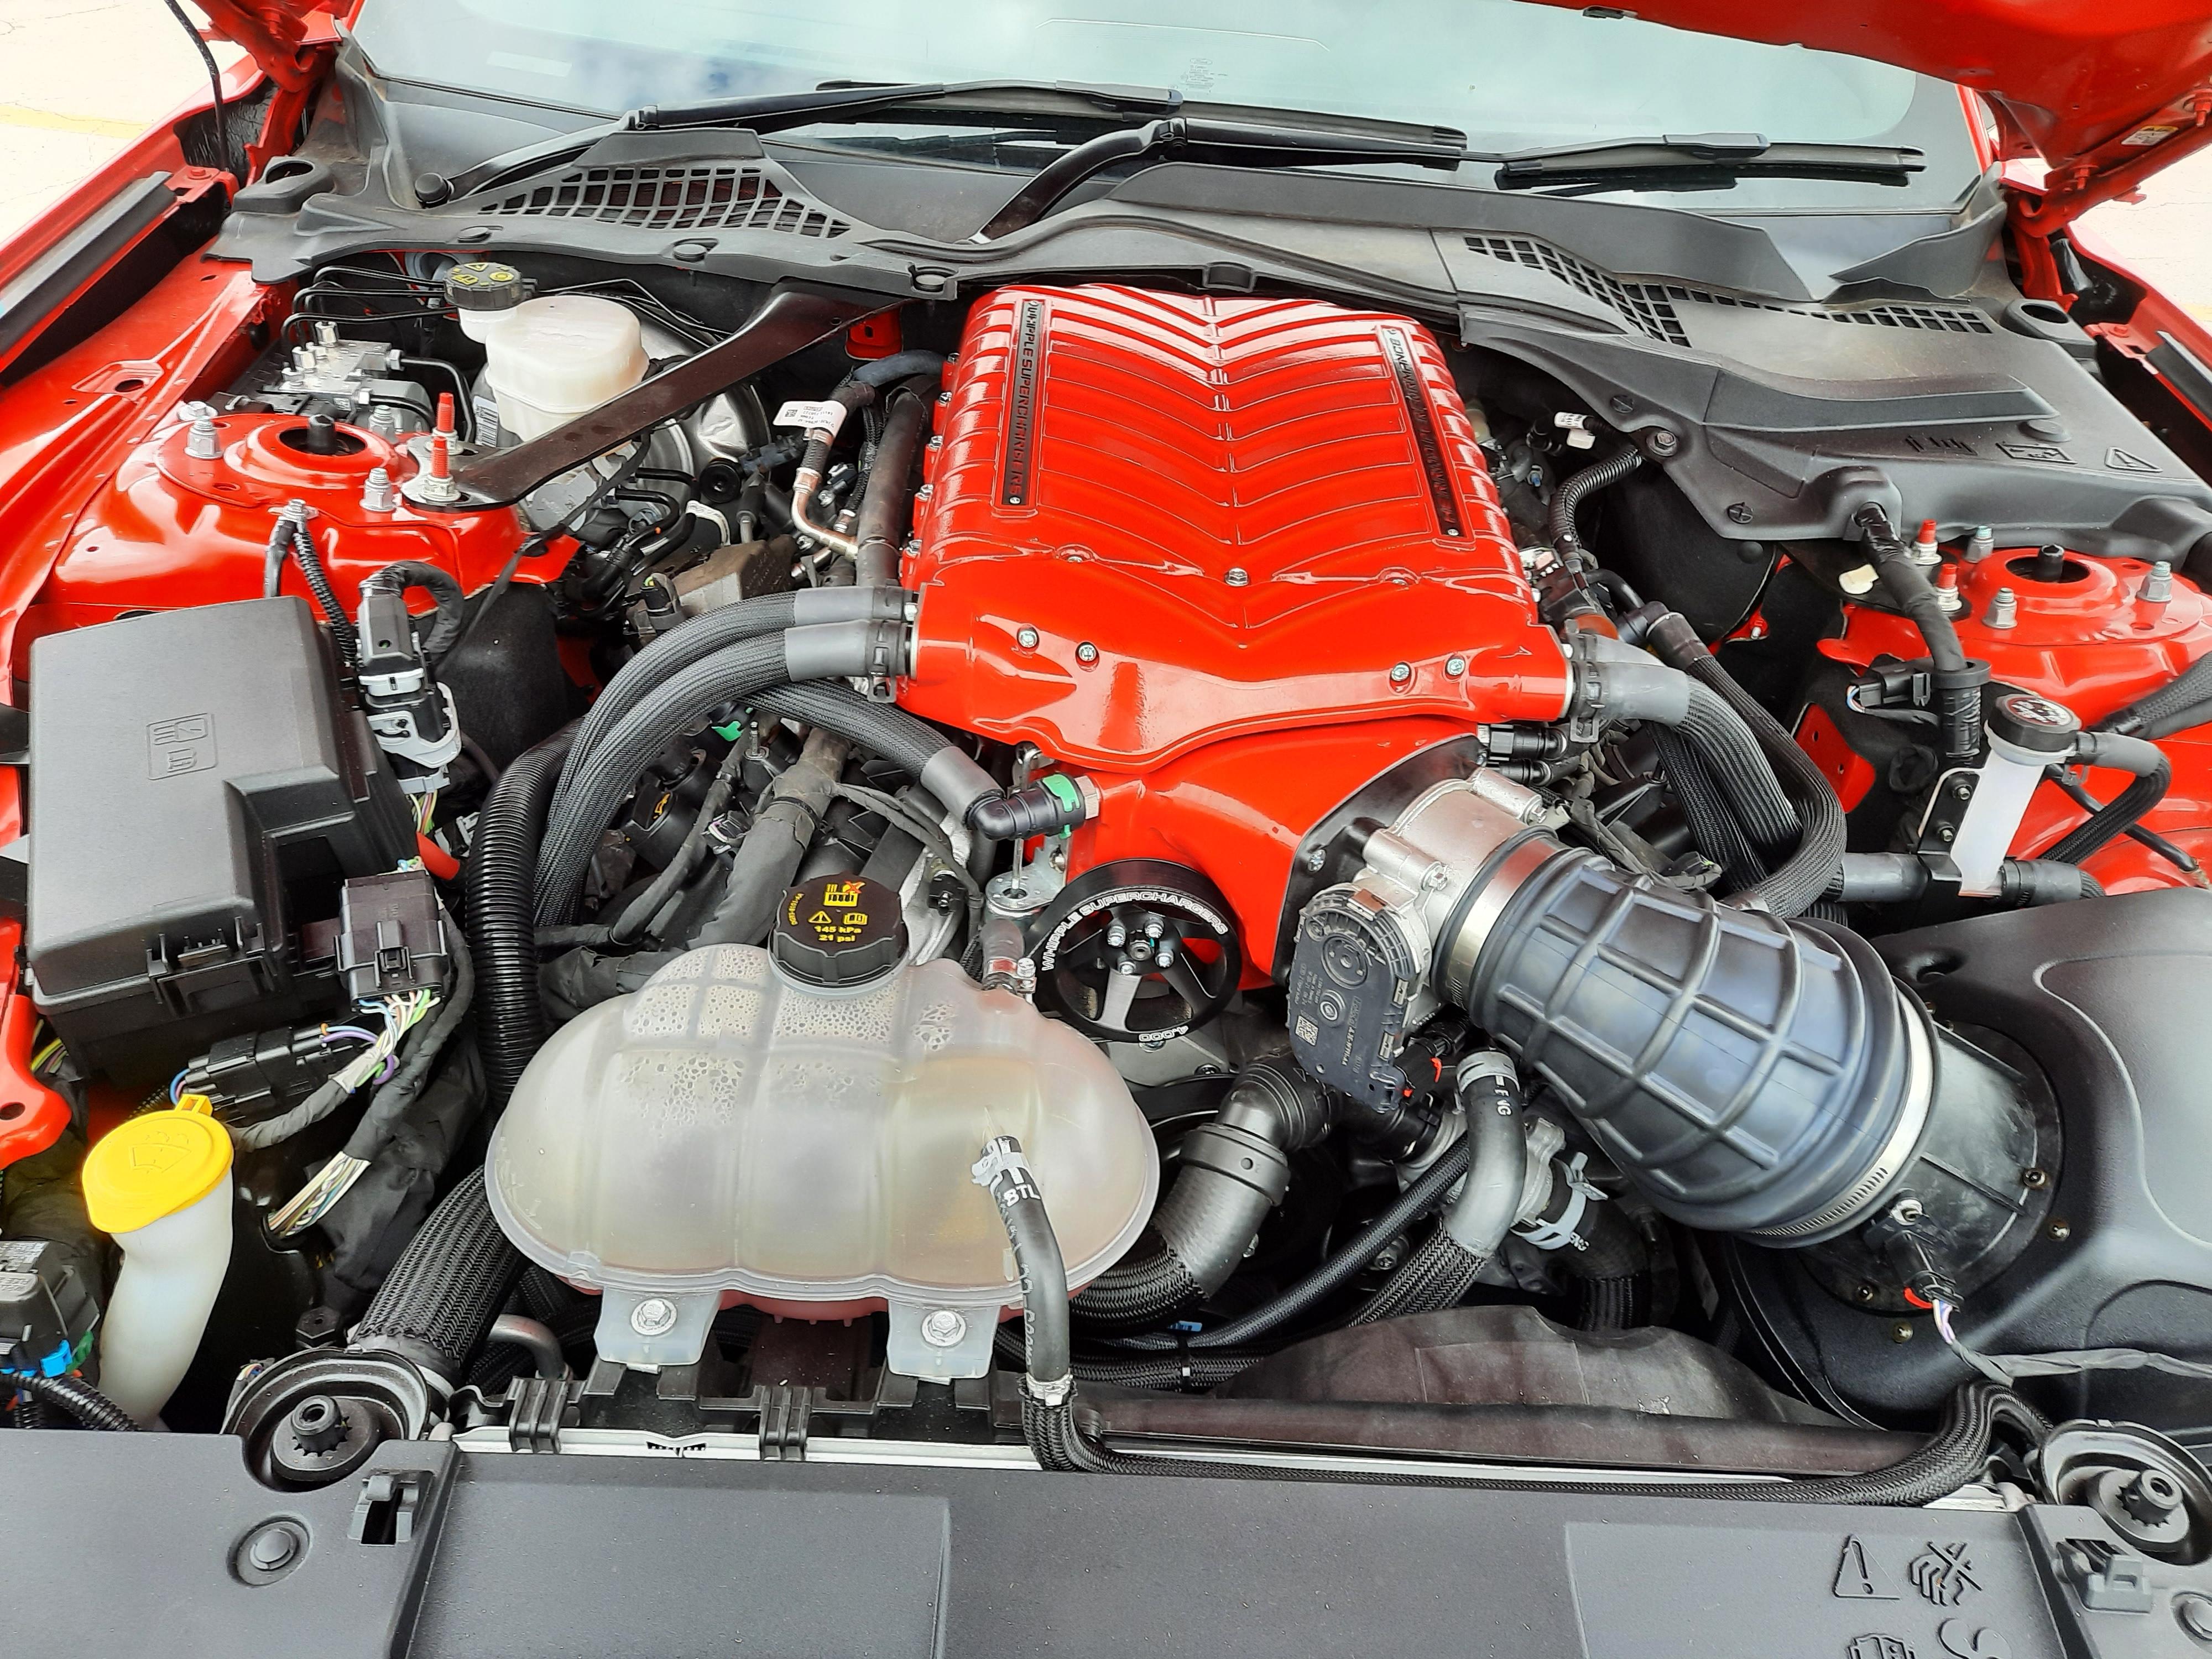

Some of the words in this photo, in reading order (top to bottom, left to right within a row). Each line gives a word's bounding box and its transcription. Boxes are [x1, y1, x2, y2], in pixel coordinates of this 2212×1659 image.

[1022, 305, 1038, 357] WHIPPLE
[1008, 358, 1033, 495] SUPERCHARGERS
[1041, 911, 1084, 972] WHIPPLE
[1081, 891, 1229, 935] SUPERCHARGERS
[1494, 1088, 1512, 1117] ENG
